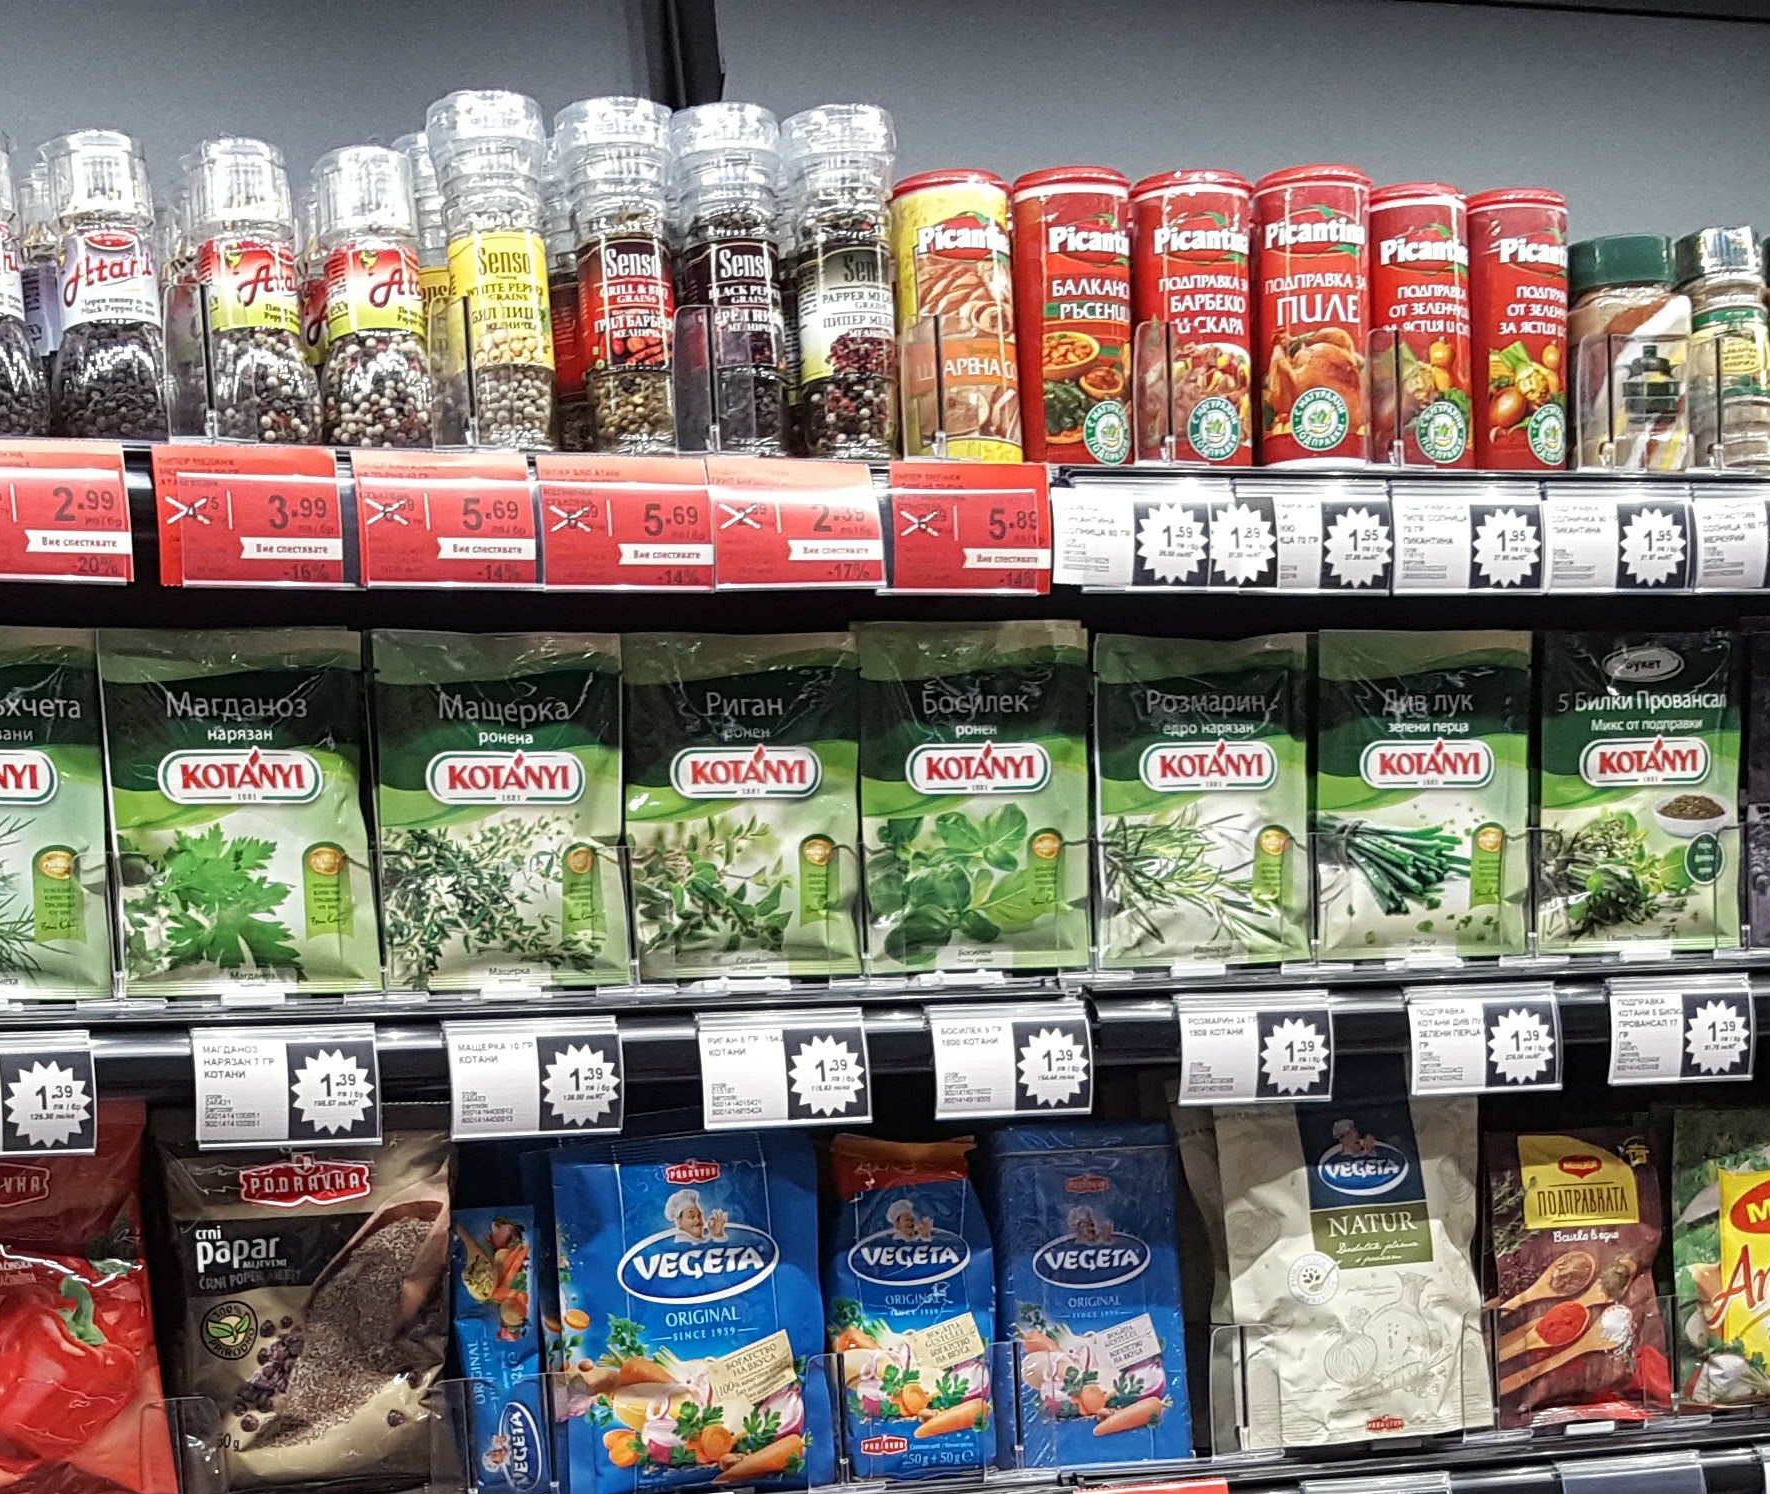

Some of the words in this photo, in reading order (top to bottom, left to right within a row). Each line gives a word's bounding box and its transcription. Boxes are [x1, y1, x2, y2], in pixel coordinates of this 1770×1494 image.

[1265, 275, 1347, 292] ПОДПРАВКА
[1170, 295, 1245, 314] БАРБЕКЮ
[1277, 294, 1360, 325] ПИЛЕ
[461, 499, 520, 530] 5.69
[167, 692, 307, 722] Магданоз
[438, 694, 569, 725] Мащерка
[706, 692, 783, 721] Риган
[922, 690, 1029, 715] Босилек
[1147, 692, 1265, 718] Розмарин
[1383, 693, 1426, 718] Див
[1434, 694, 1473, 718] лук
[1558, 693, 1569, 713] 5
[1575, 692, 1631, 711] Билки
[208, 727, 273, 743] нарязан
[479, 731, 533, 745] ронена
[956, 724, 997, 739] ронен
[1388, 721, 1425, 734] зелени
[1429, 721, 1469, 735] перца
[1329, 1211, 1416, 1239] NATUR
[195, 1233, 278, 1272] papar
[634, 1249, 765, 1281] VEGETA
[1045, 1248, 1138, 1271] VEGETA
[665, 1307, 740, 1326] ORIGINAL
